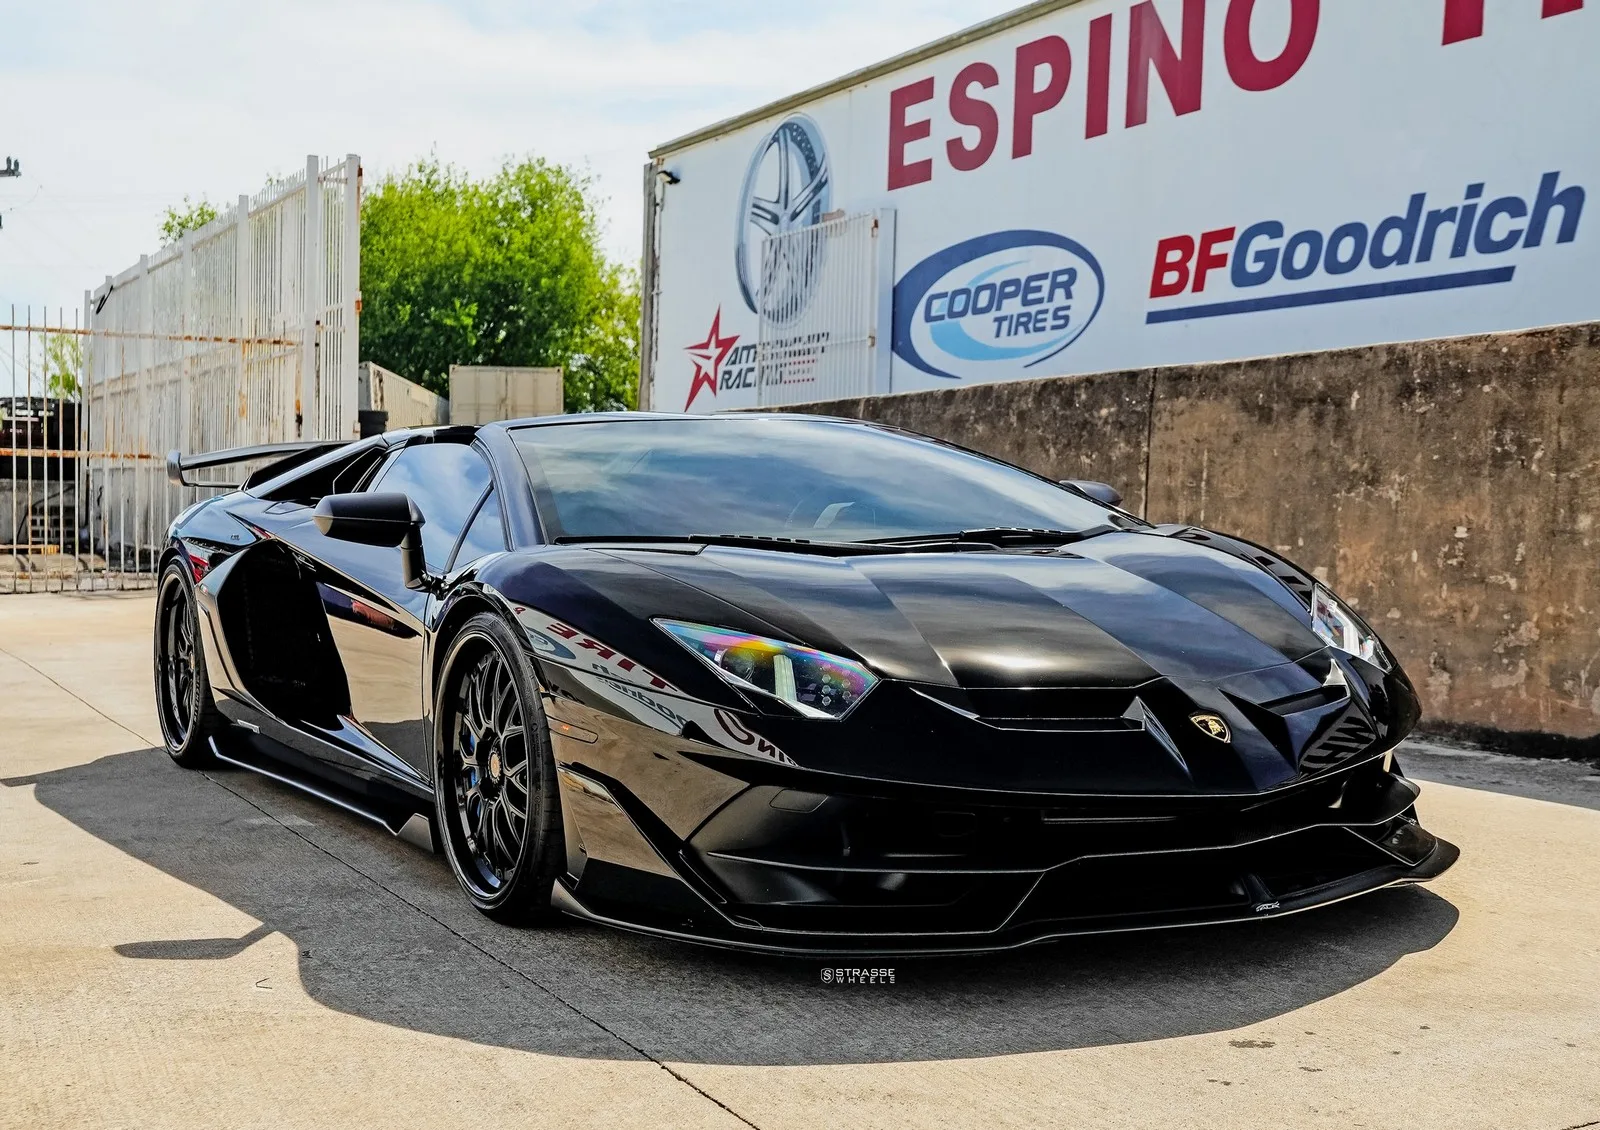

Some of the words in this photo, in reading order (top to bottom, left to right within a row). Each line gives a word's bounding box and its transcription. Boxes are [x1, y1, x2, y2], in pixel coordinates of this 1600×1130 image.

[888, 0, 1320, 191] ESPINO
[1149, 171, 1586, 298] BFGoodrich
[924, 267, 1077, 323] COOPER
[993, 305, 1071, 338] TIRES
